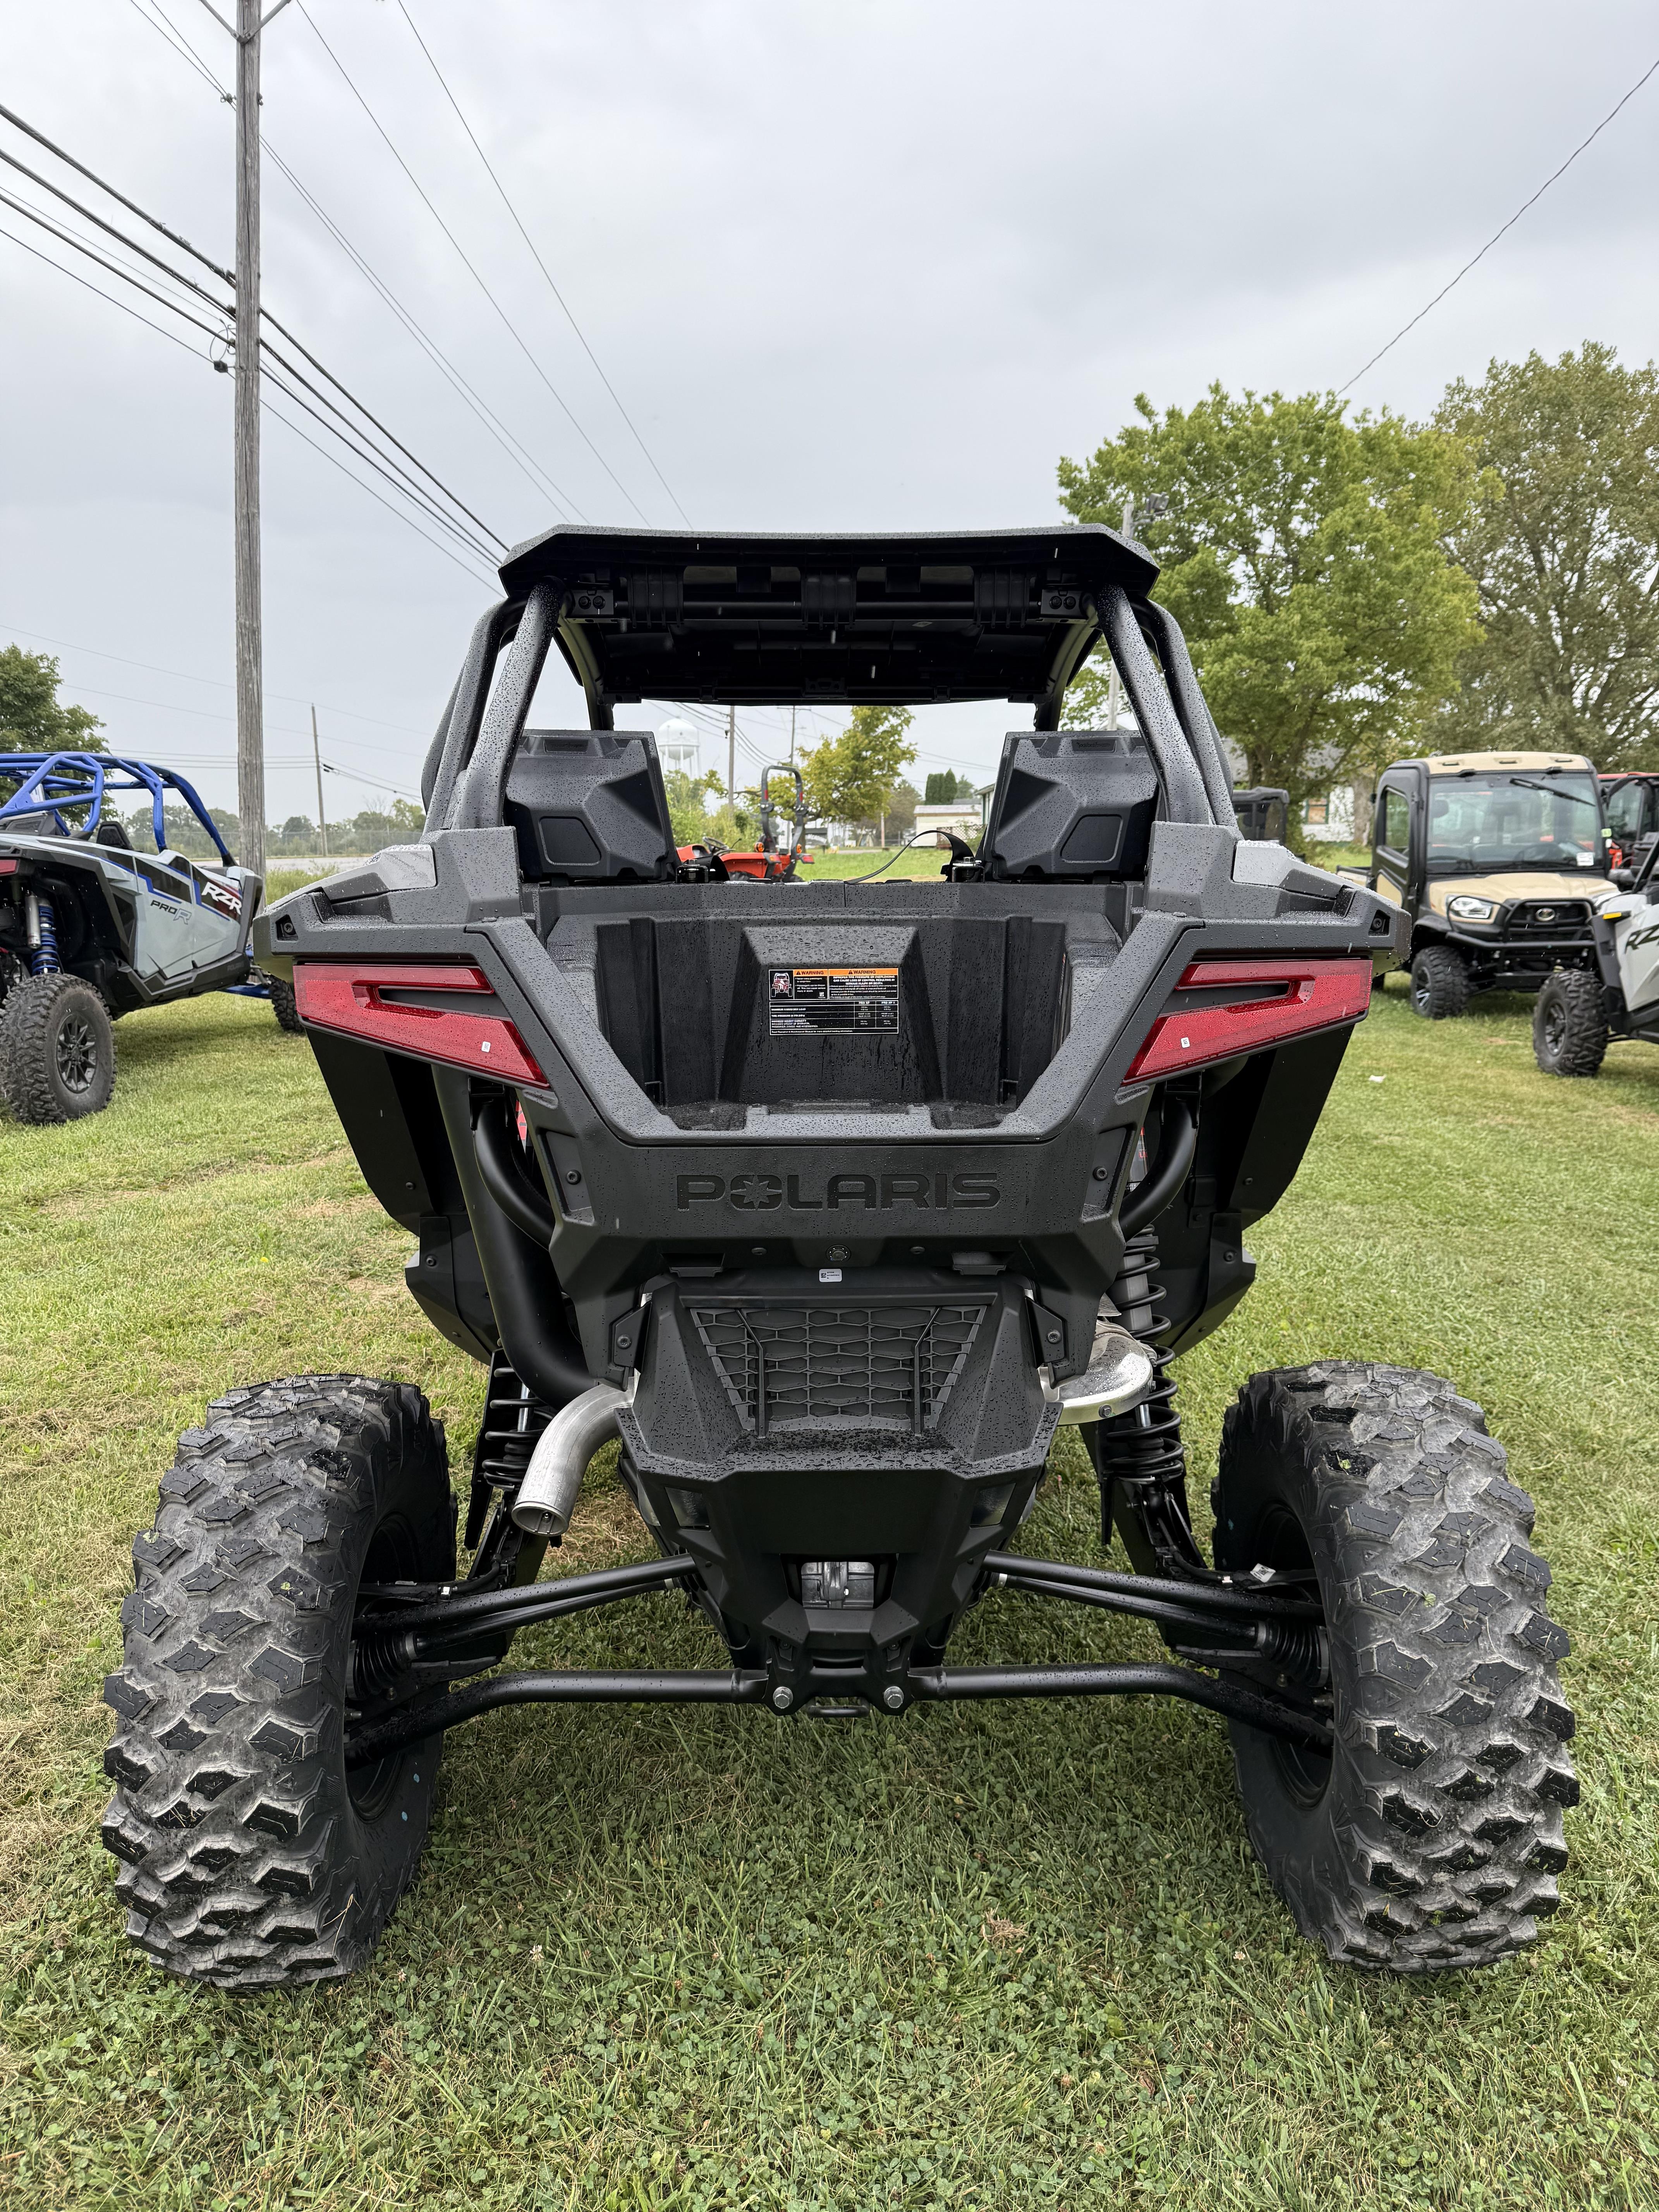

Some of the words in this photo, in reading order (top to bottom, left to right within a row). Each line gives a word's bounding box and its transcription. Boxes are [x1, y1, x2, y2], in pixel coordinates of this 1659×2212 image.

[150, 900, 178, 915] PRO
[201, 882, 242, 915] RZR
[1624, 924, 1659, 954] RZ
[677, 1173, 1001, 1211] POLARIS
